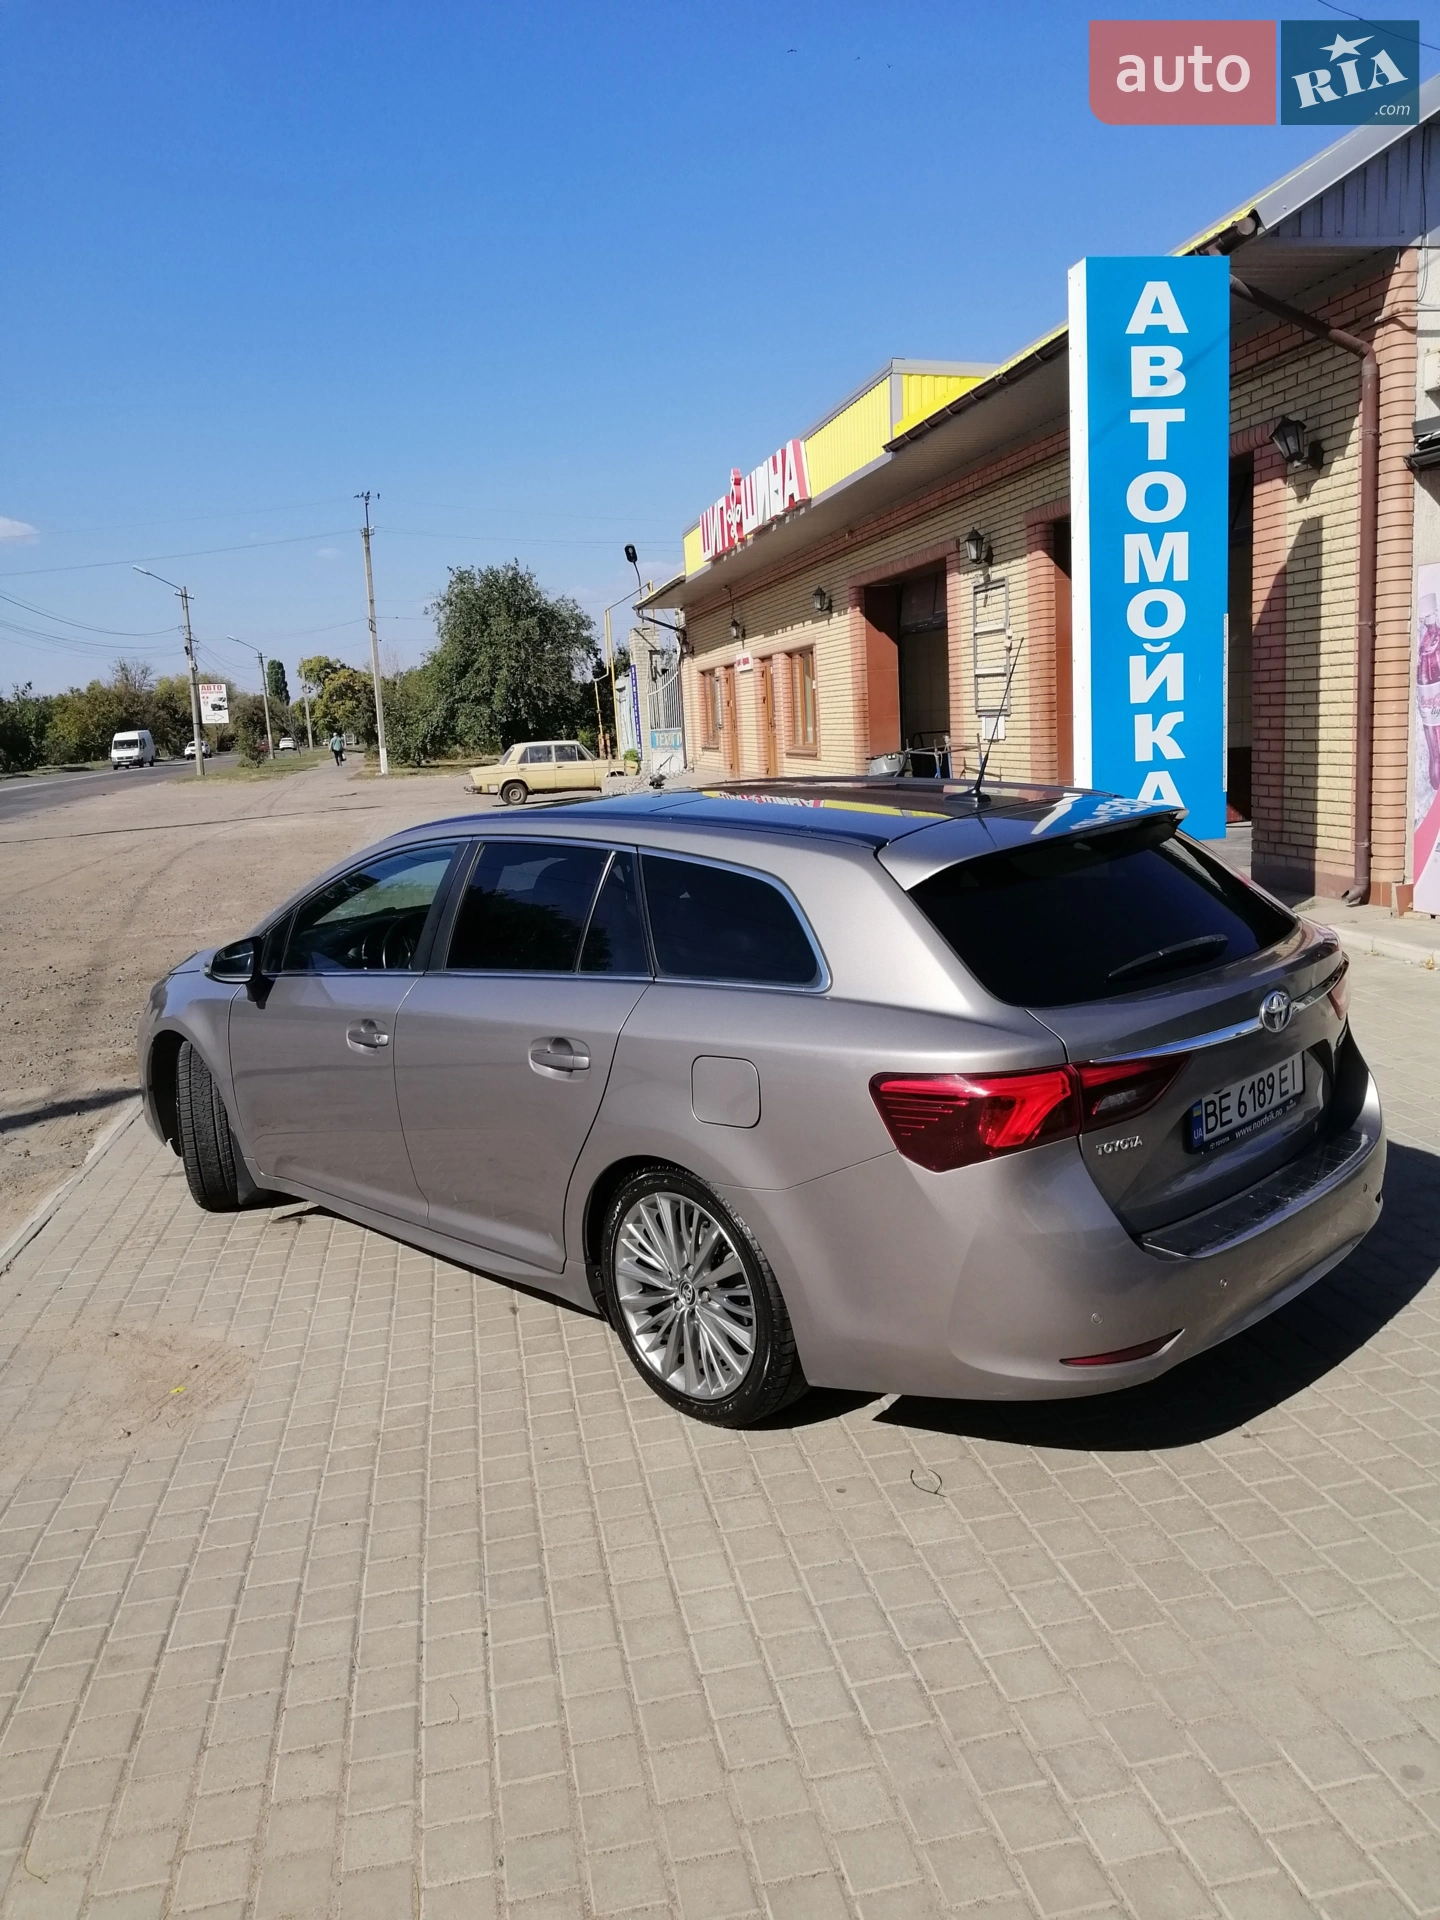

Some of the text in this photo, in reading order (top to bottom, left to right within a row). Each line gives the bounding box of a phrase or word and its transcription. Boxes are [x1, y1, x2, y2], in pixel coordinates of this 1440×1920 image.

[700, 495, 734, 563] ШИП
[740, 439, 808, 536] ШИНА
[1123, 280, 1190, 808] АВТОМОЙКА
[1204, 1059, 1296, 1135] BE 6189 EI
[1095, 1135, 1143, 1156] TOYOTA
[1193, 1127, 1204, 1140] UA
[1215, 1136, 1230, 1147] TOYOTA
